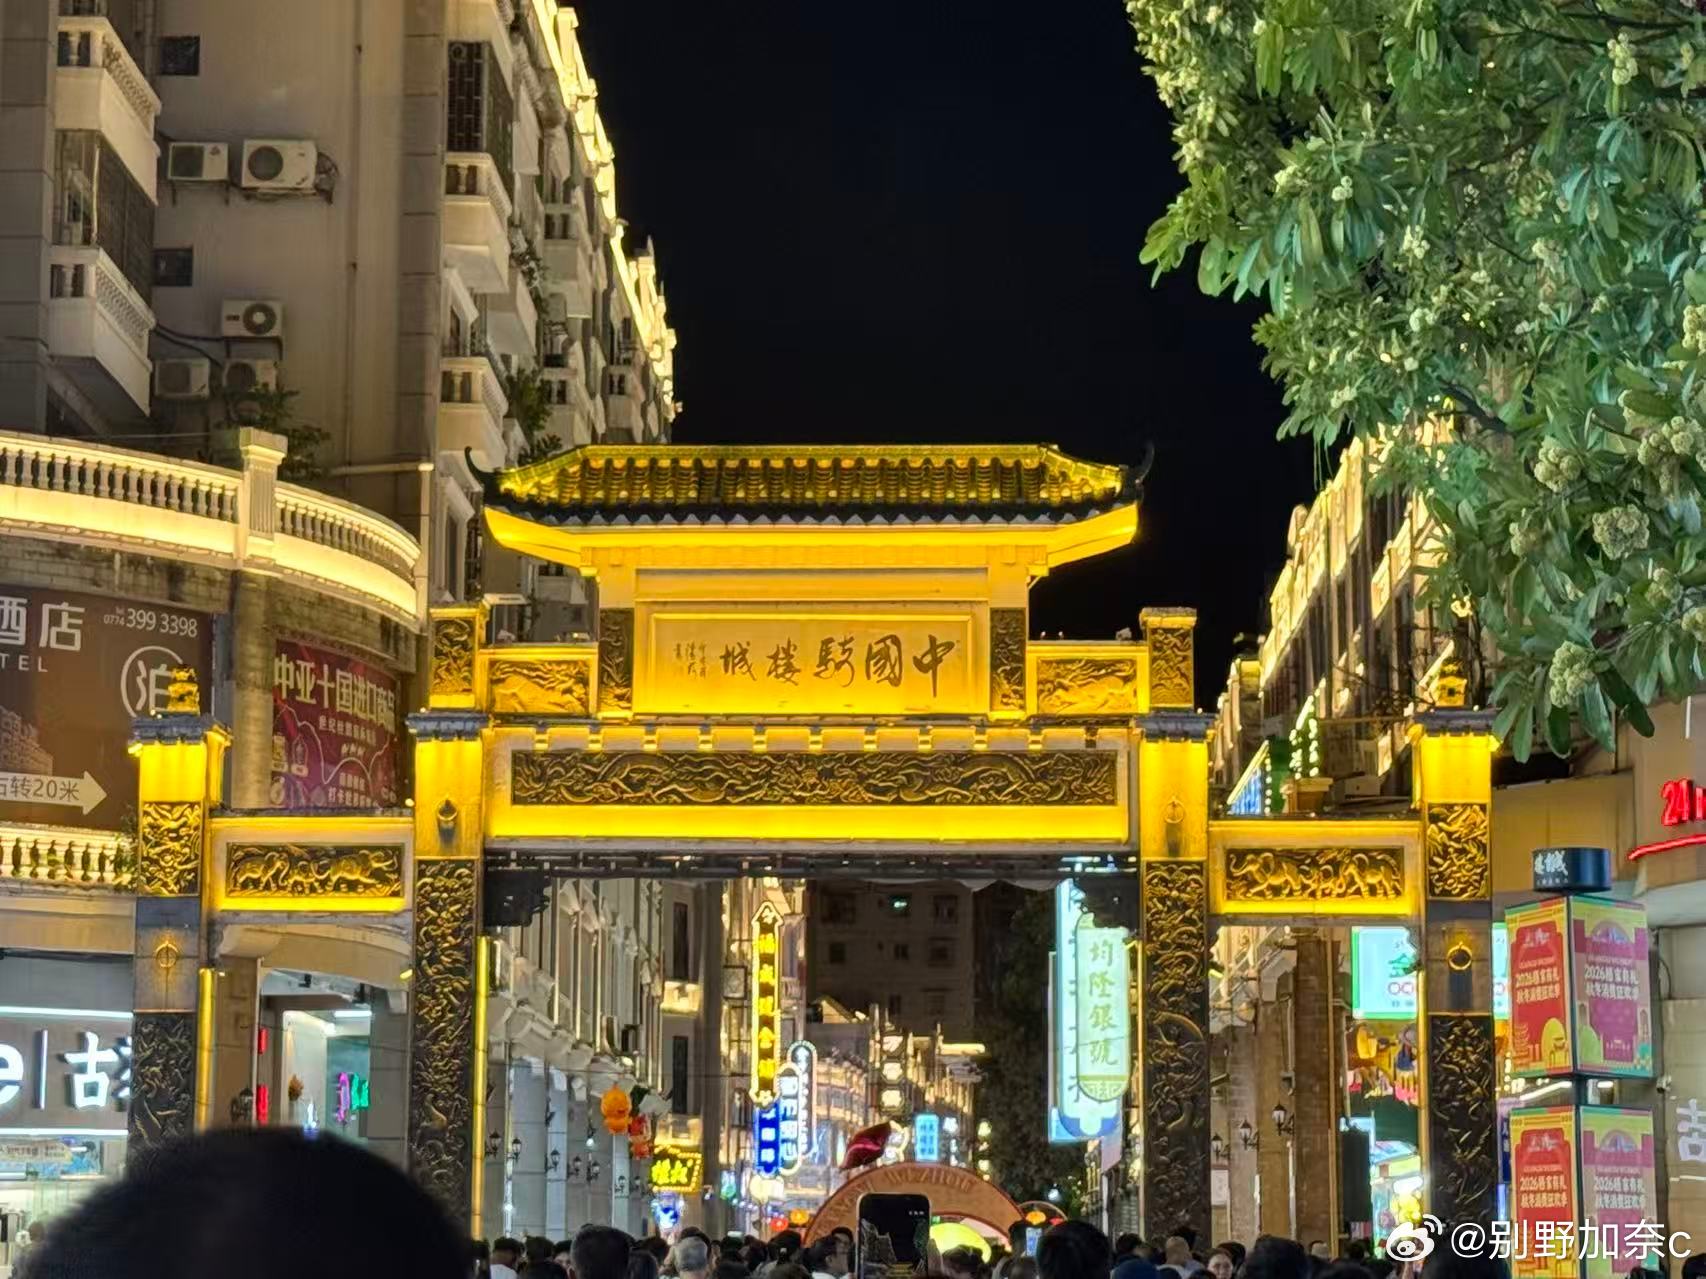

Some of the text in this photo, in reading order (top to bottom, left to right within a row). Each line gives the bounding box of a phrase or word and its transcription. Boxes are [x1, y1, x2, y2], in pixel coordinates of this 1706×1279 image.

[0, 595, 85, 652] 酒店
[126, 607, 157, 631] 399
[159, 612, 198, 638] 3398
[274, 653, 395, 735] 中亚十国进口商品
